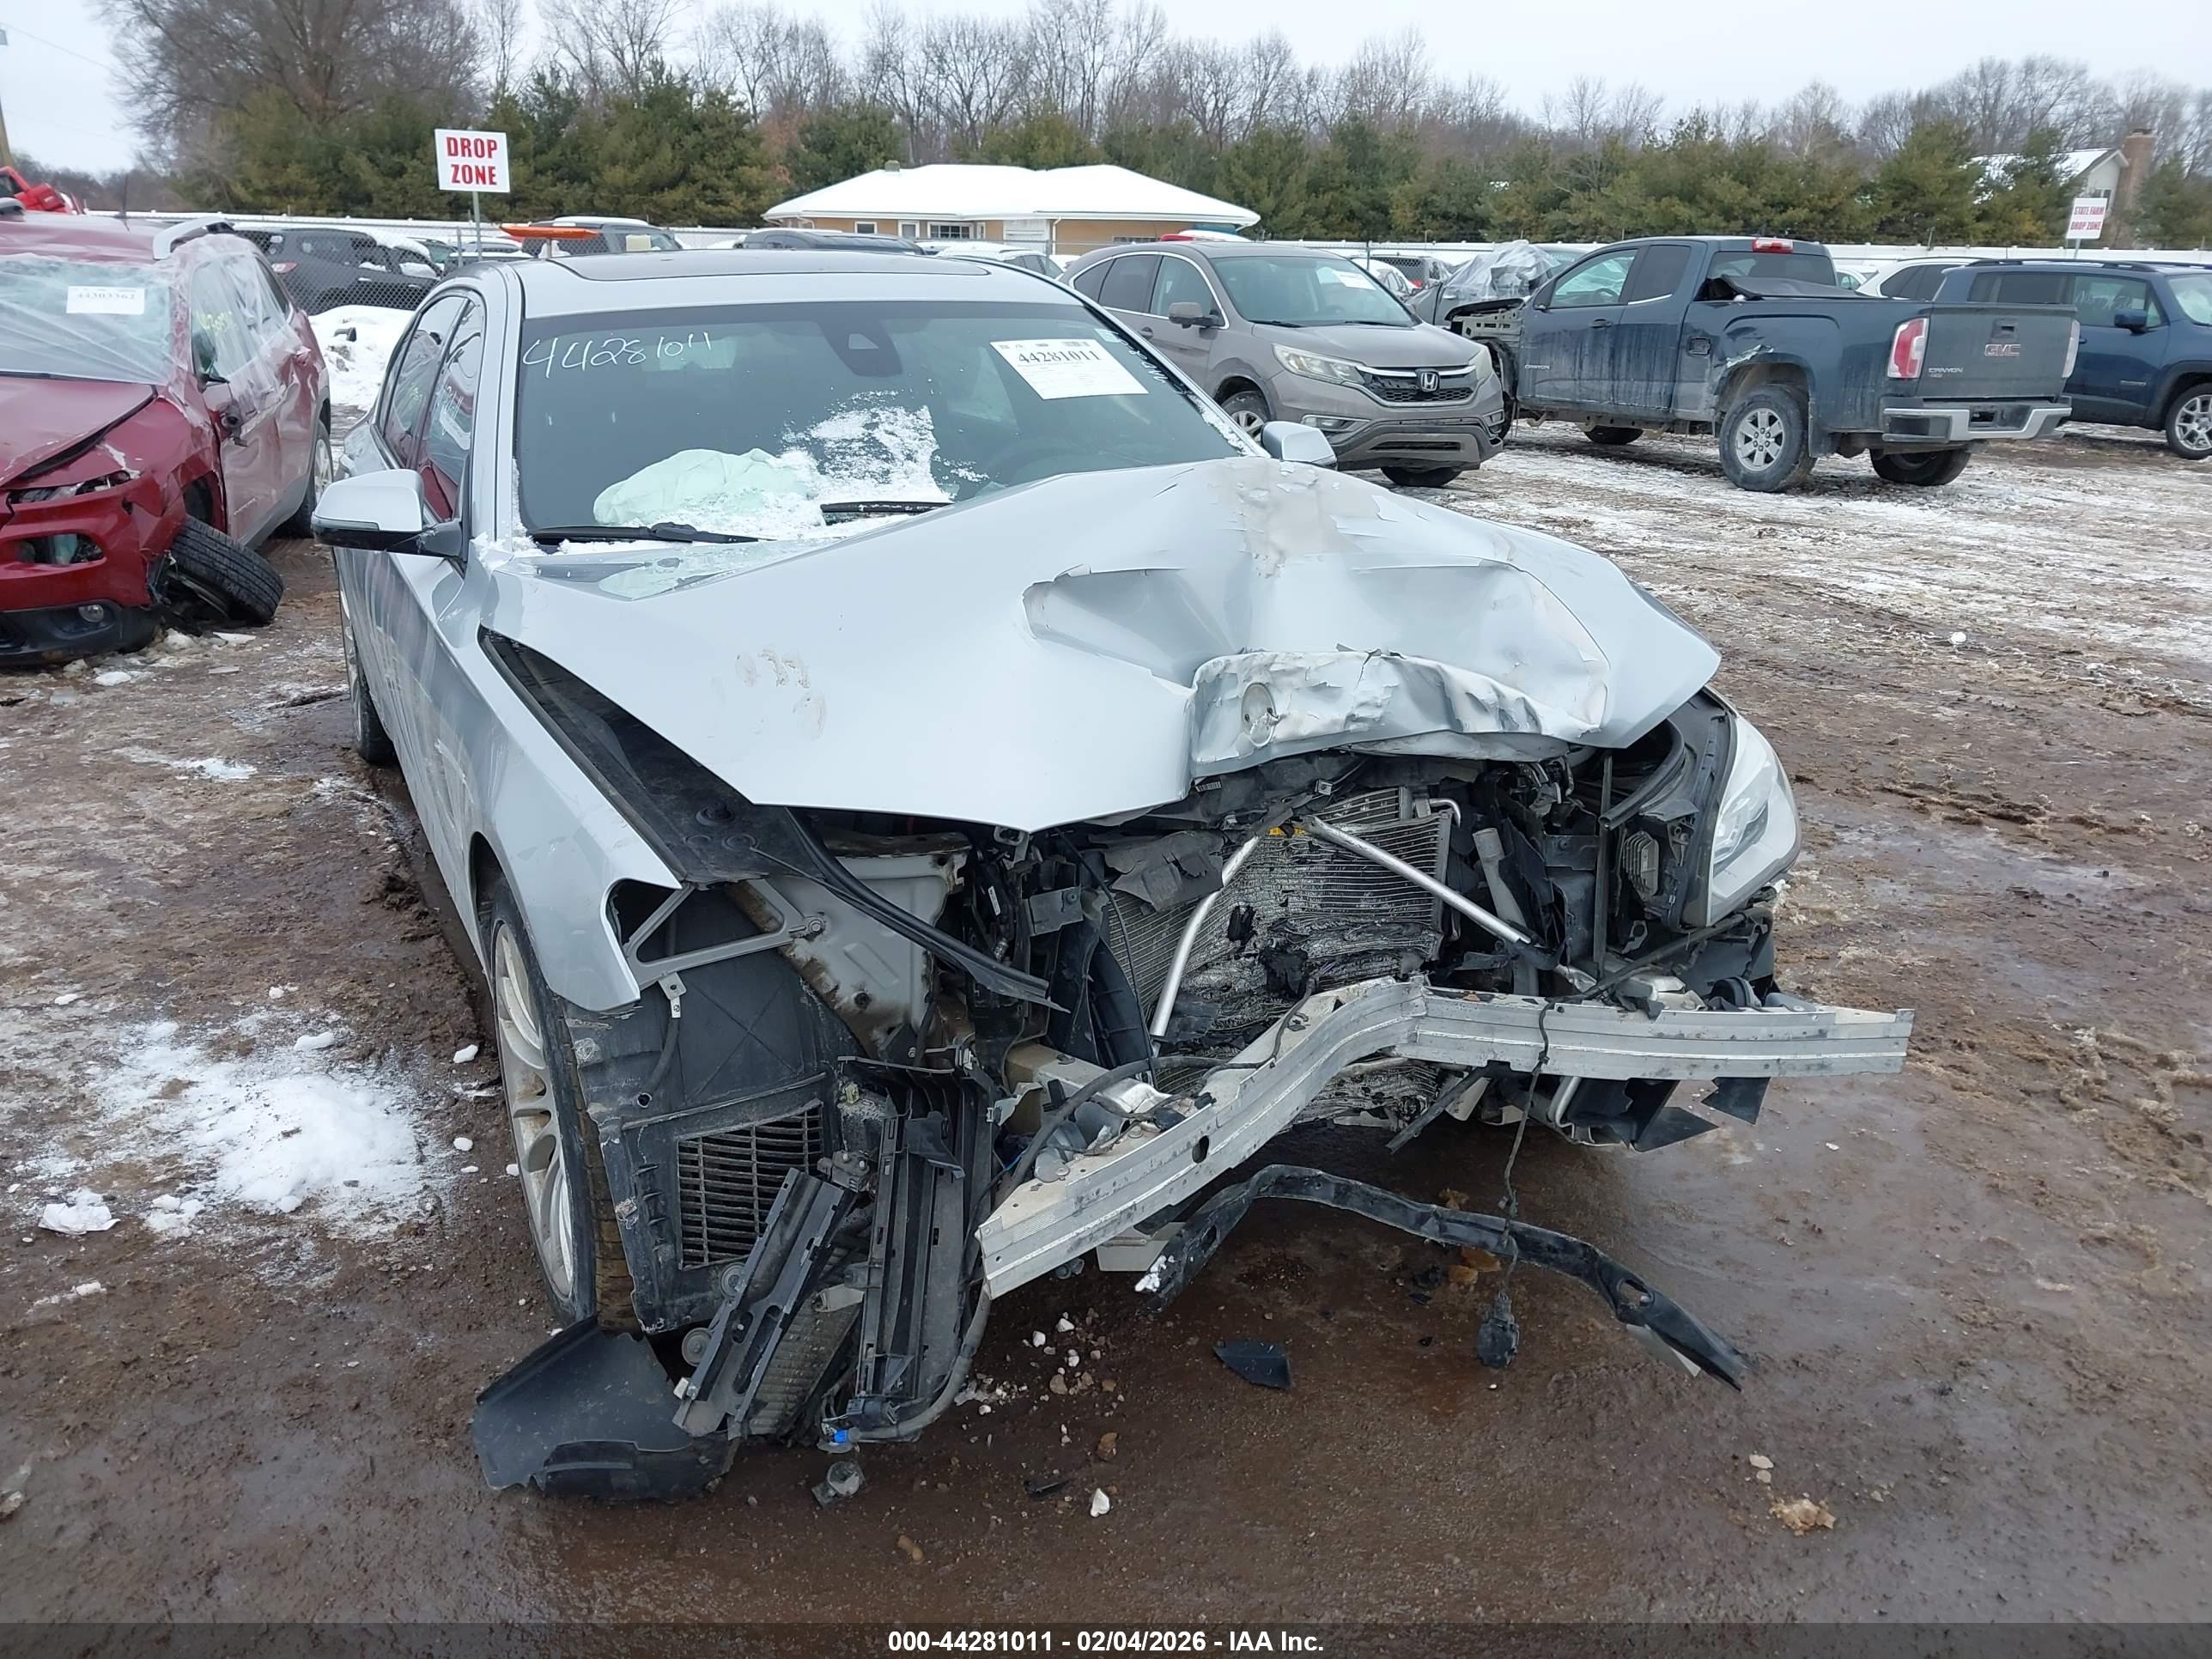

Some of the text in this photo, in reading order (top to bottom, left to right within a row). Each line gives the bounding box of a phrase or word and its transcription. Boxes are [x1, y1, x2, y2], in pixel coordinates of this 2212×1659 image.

[446, 137, 498, 159] DROP
[451, 163, 498, 185] ZONE
[2069, 221, 2102, 230] DROP ZONE
[1984, 343, 2021, 356] GMC
[1018, 350, 1101, 363] 44281011
